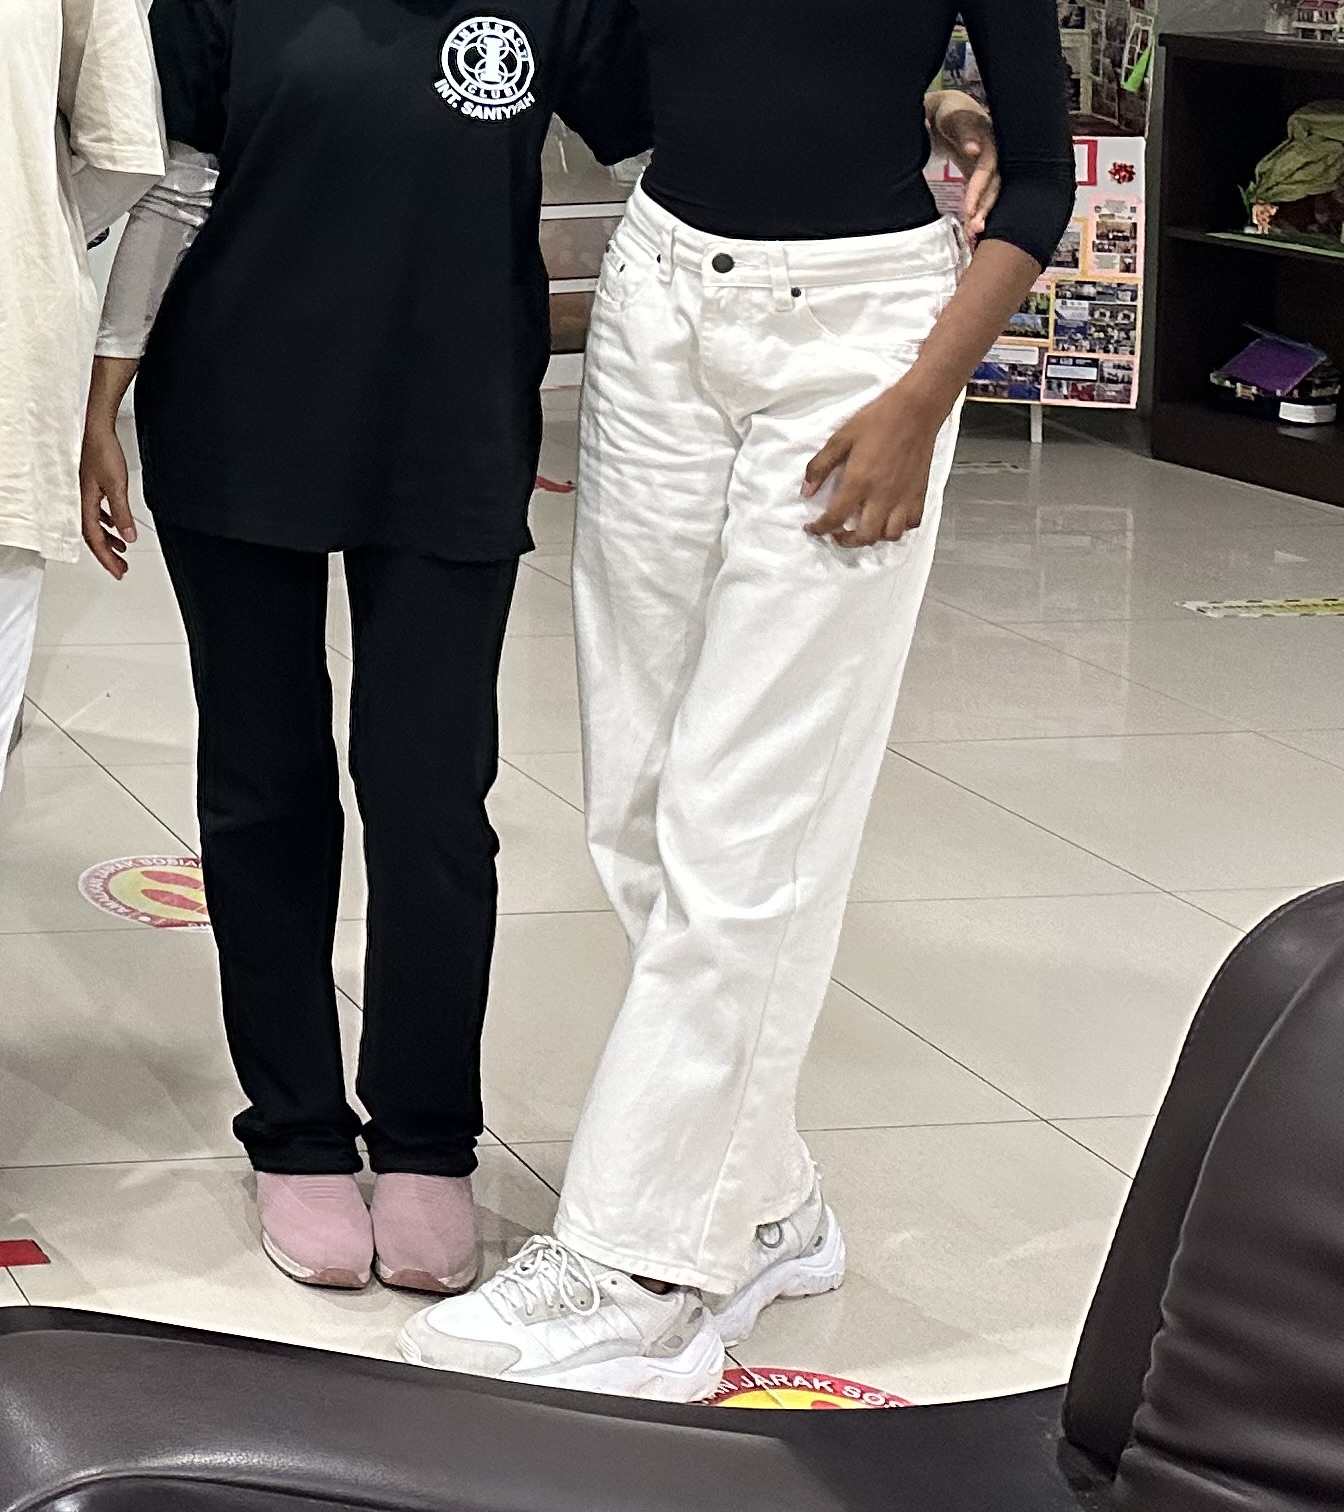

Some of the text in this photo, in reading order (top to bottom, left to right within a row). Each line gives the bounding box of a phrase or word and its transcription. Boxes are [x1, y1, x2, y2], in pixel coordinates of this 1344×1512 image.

[451, 21, 529, 59] INTERACT
[434, 79, 536, 121] INT. SANIYYAH
[467, 84, 515, 99] CLUB
[140, 858, 201, 869] SOSIA
[740, 1373, 834, 1393] JARAK
